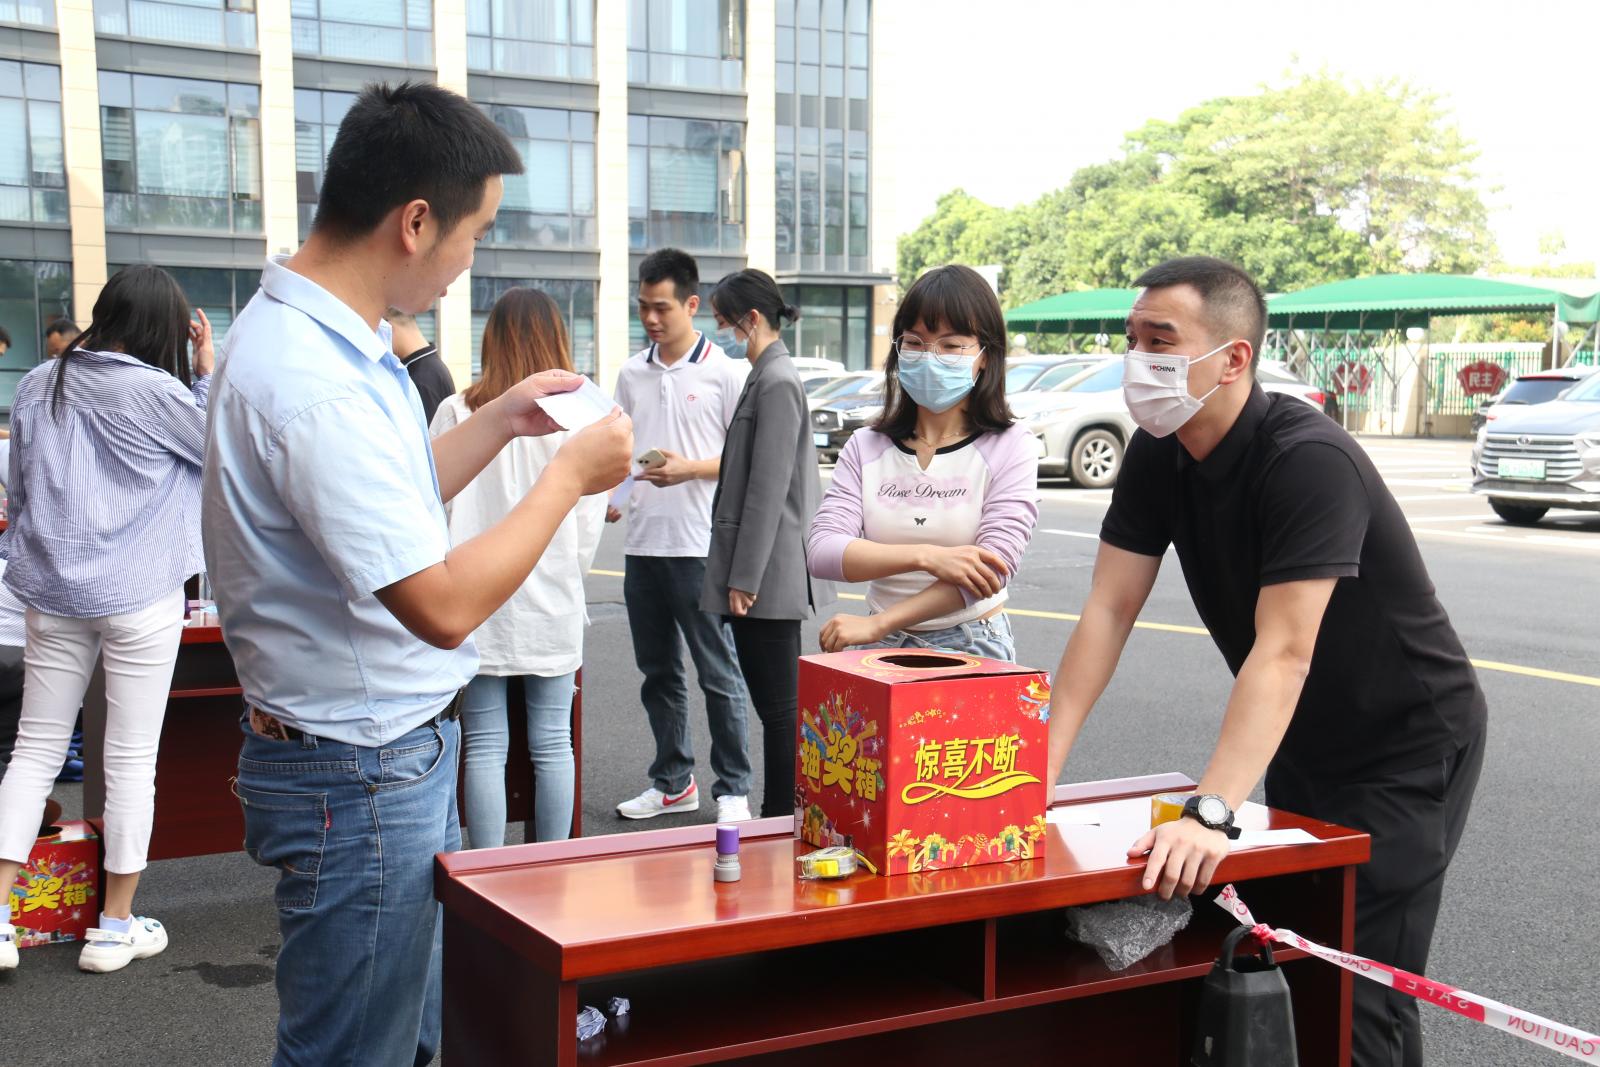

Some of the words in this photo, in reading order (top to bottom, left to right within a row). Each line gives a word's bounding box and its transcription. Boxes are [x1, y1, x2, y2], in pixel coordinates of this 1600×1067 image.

[1469, 372, 1492, 387] 民主
[878, 483, 911, 498] Rose
[914, 483, 967, 498] Dream
[801, 730, 877, 801] 抽奖箱
[915, 734, 1019, 781] 惊喜不断
